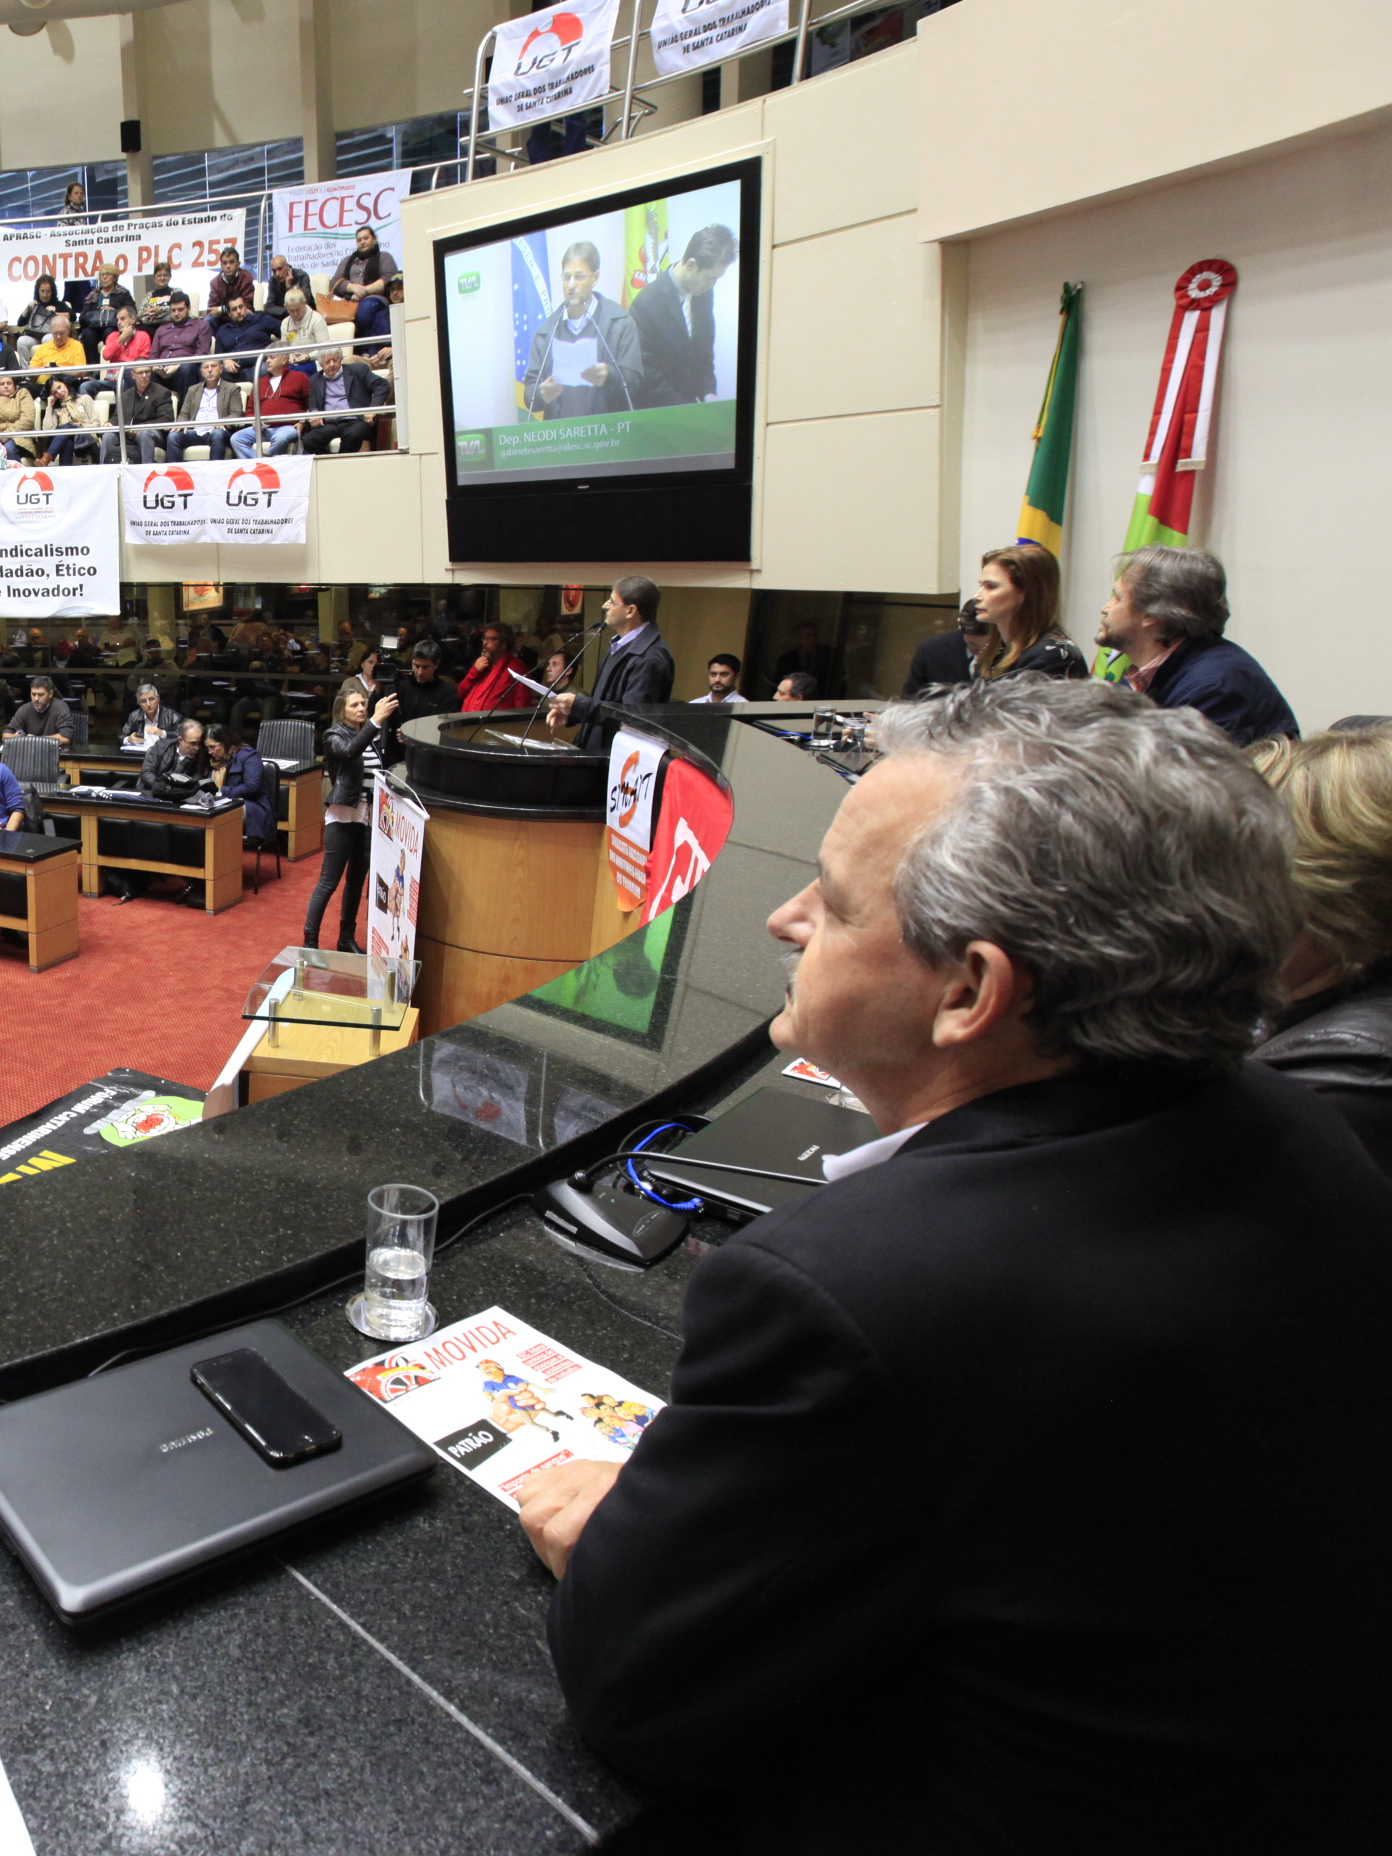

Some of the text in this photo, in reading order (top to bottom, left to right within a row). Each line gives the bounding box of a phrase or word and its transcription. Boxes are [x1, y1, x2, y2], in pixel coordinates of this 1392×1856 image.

[679, 28, 701, 42] GERAL
[703, 21, 717, 33] DOS
[692, 37, 714, 51] SANTA
[715, 23, 747, 44] CATARINA
[514, 40, 582, 77] UGT
[514, 88, 534, 103] GERAL
[534, 84, 546, 95] DOS
[516, 104, 525, 113] DE
[525, 97, 545, 110] SANTA
[288, 187, 395, 233] FECESC
[3, 215, 217, 242] APRASC Associação de Praças do Estado
[65, 233, 142, 247] Santa Catarina
[288, 243, 322, 253] Federação
[8, 250, 105, 281] CONTRA
[138, 243, 182, 272] PLC
[191, 237, 238, 268] 257
[287, 251, 334, 262] Trabalhadores
[499, 421, 632, 446] Dep. NEODI SARETTA PT
[16, 492, 54, 507] UGT
[142, 492, 194, 511] UGT
[225, 490, 280, 510] UGT
[252, 517, 294, 525] TRABALHADORES
[55, 558, 97, 577] Ético
[7, 583, 84, 598] Inovador!
[395, 810, 420, 859] MOVIDA
[71, 1087, 117, 1115] FÓRUM
[423, 1320, 517, 1370] MOVIDA
[448, 1430, 494, 1458] PATRÃO
